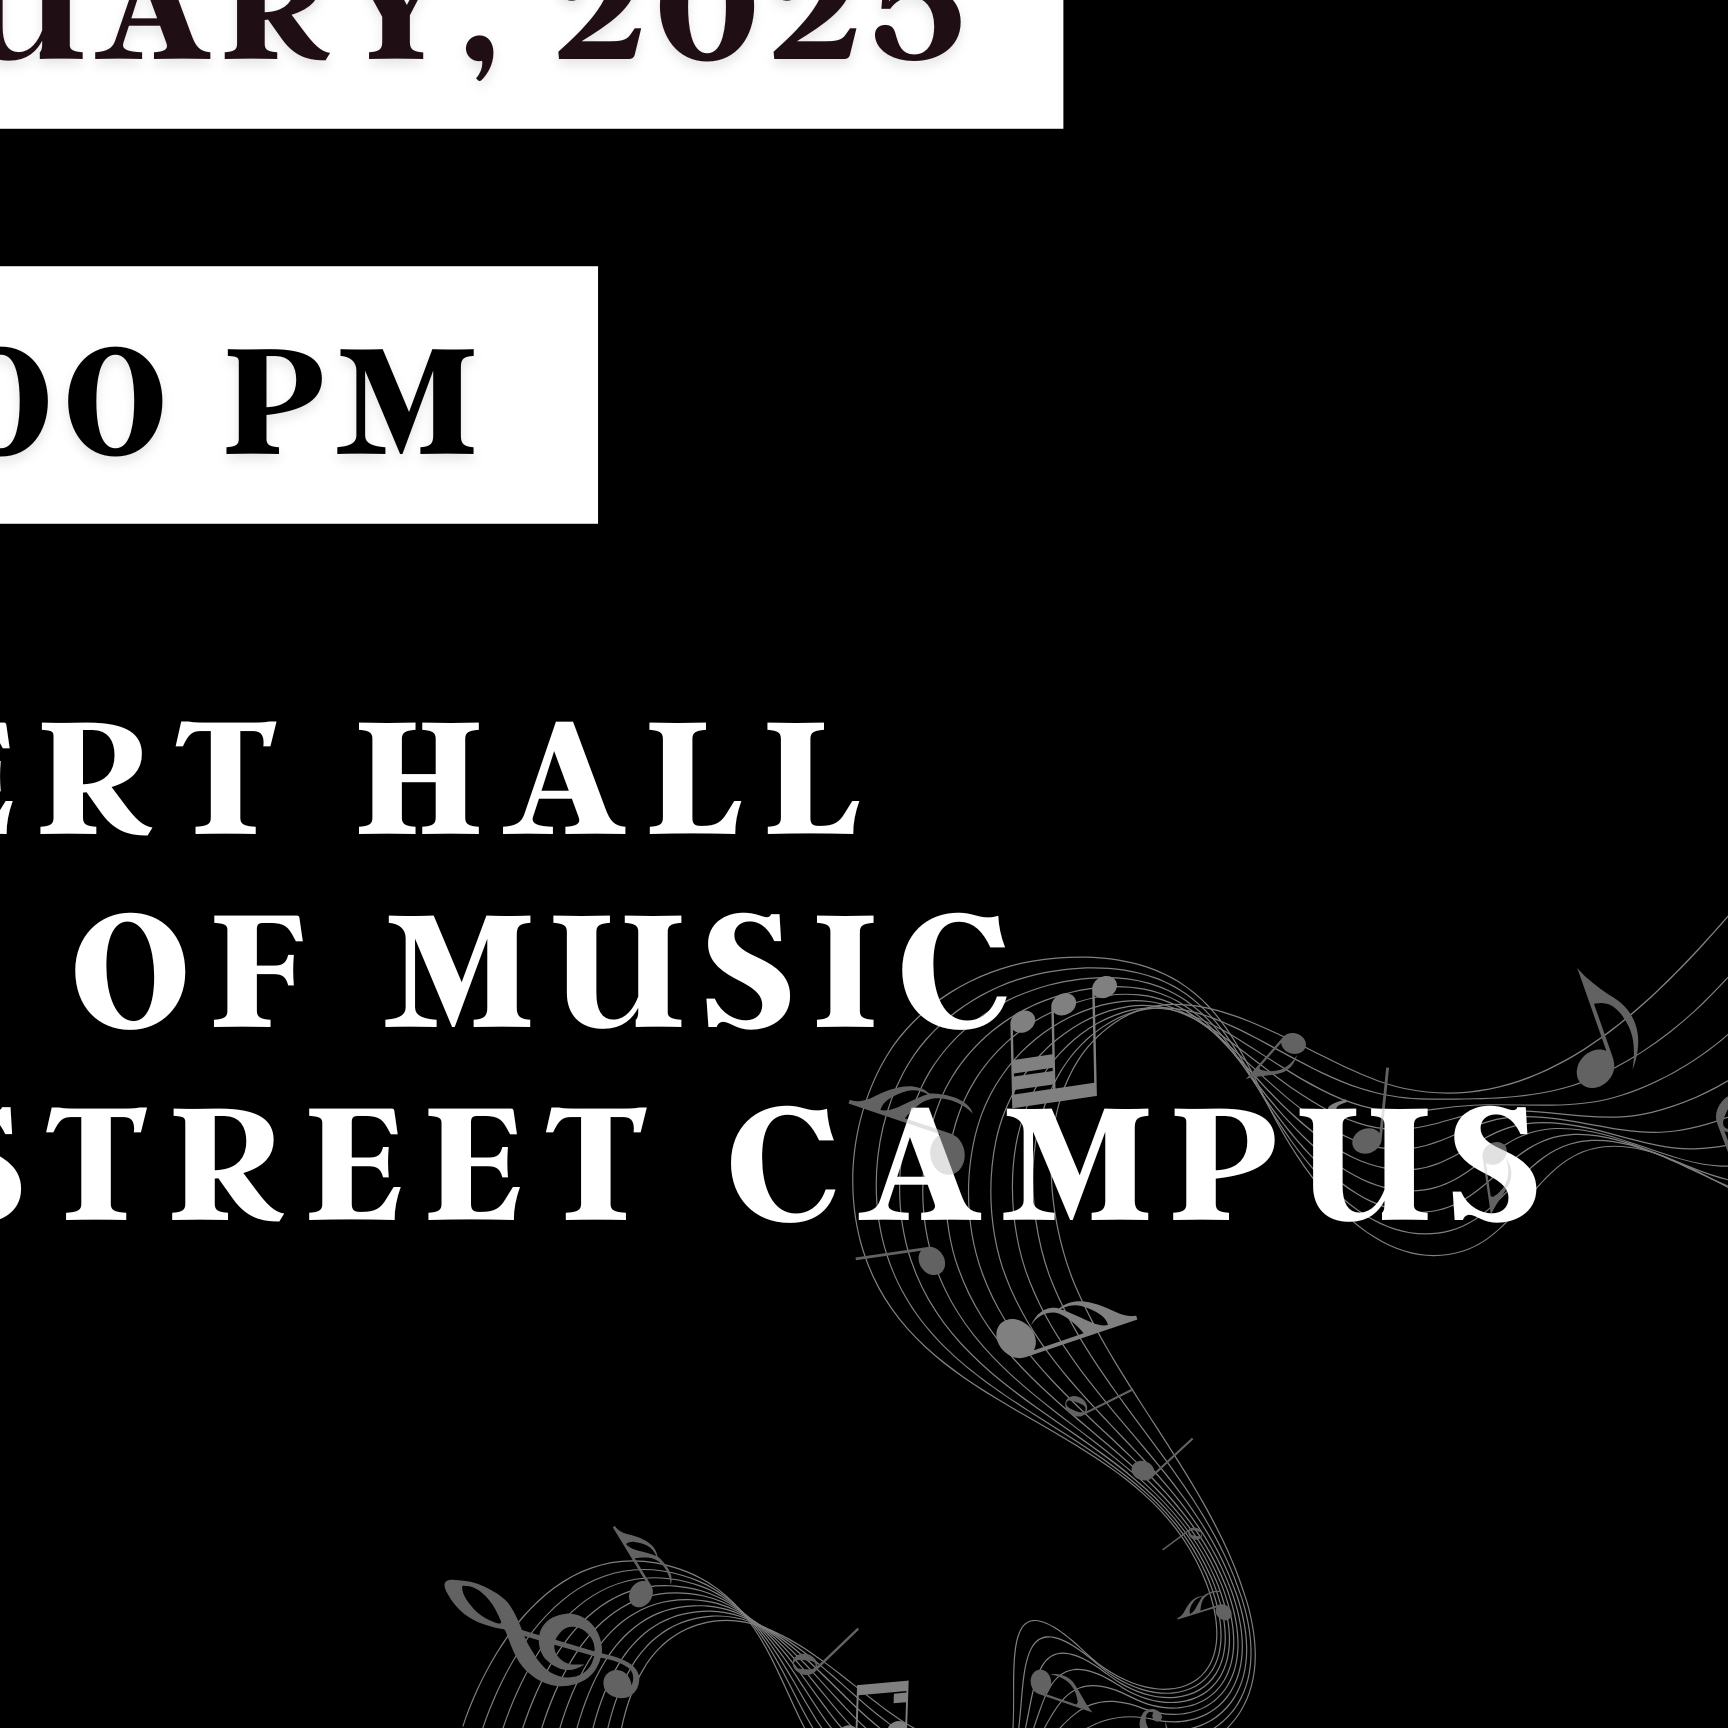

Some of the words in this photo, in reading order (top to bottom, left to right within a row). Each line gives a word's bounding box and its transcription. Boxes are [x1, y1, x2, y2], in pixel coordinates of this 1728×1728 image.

[224, 346, 475, 458] PM
[357, 718, 860, 838] HALL
[73, 911, 304, 1031] OF
[383, 911, 1007, 1031] MUSIC
[729, 1104, 1538, 1224] CAMPUS
